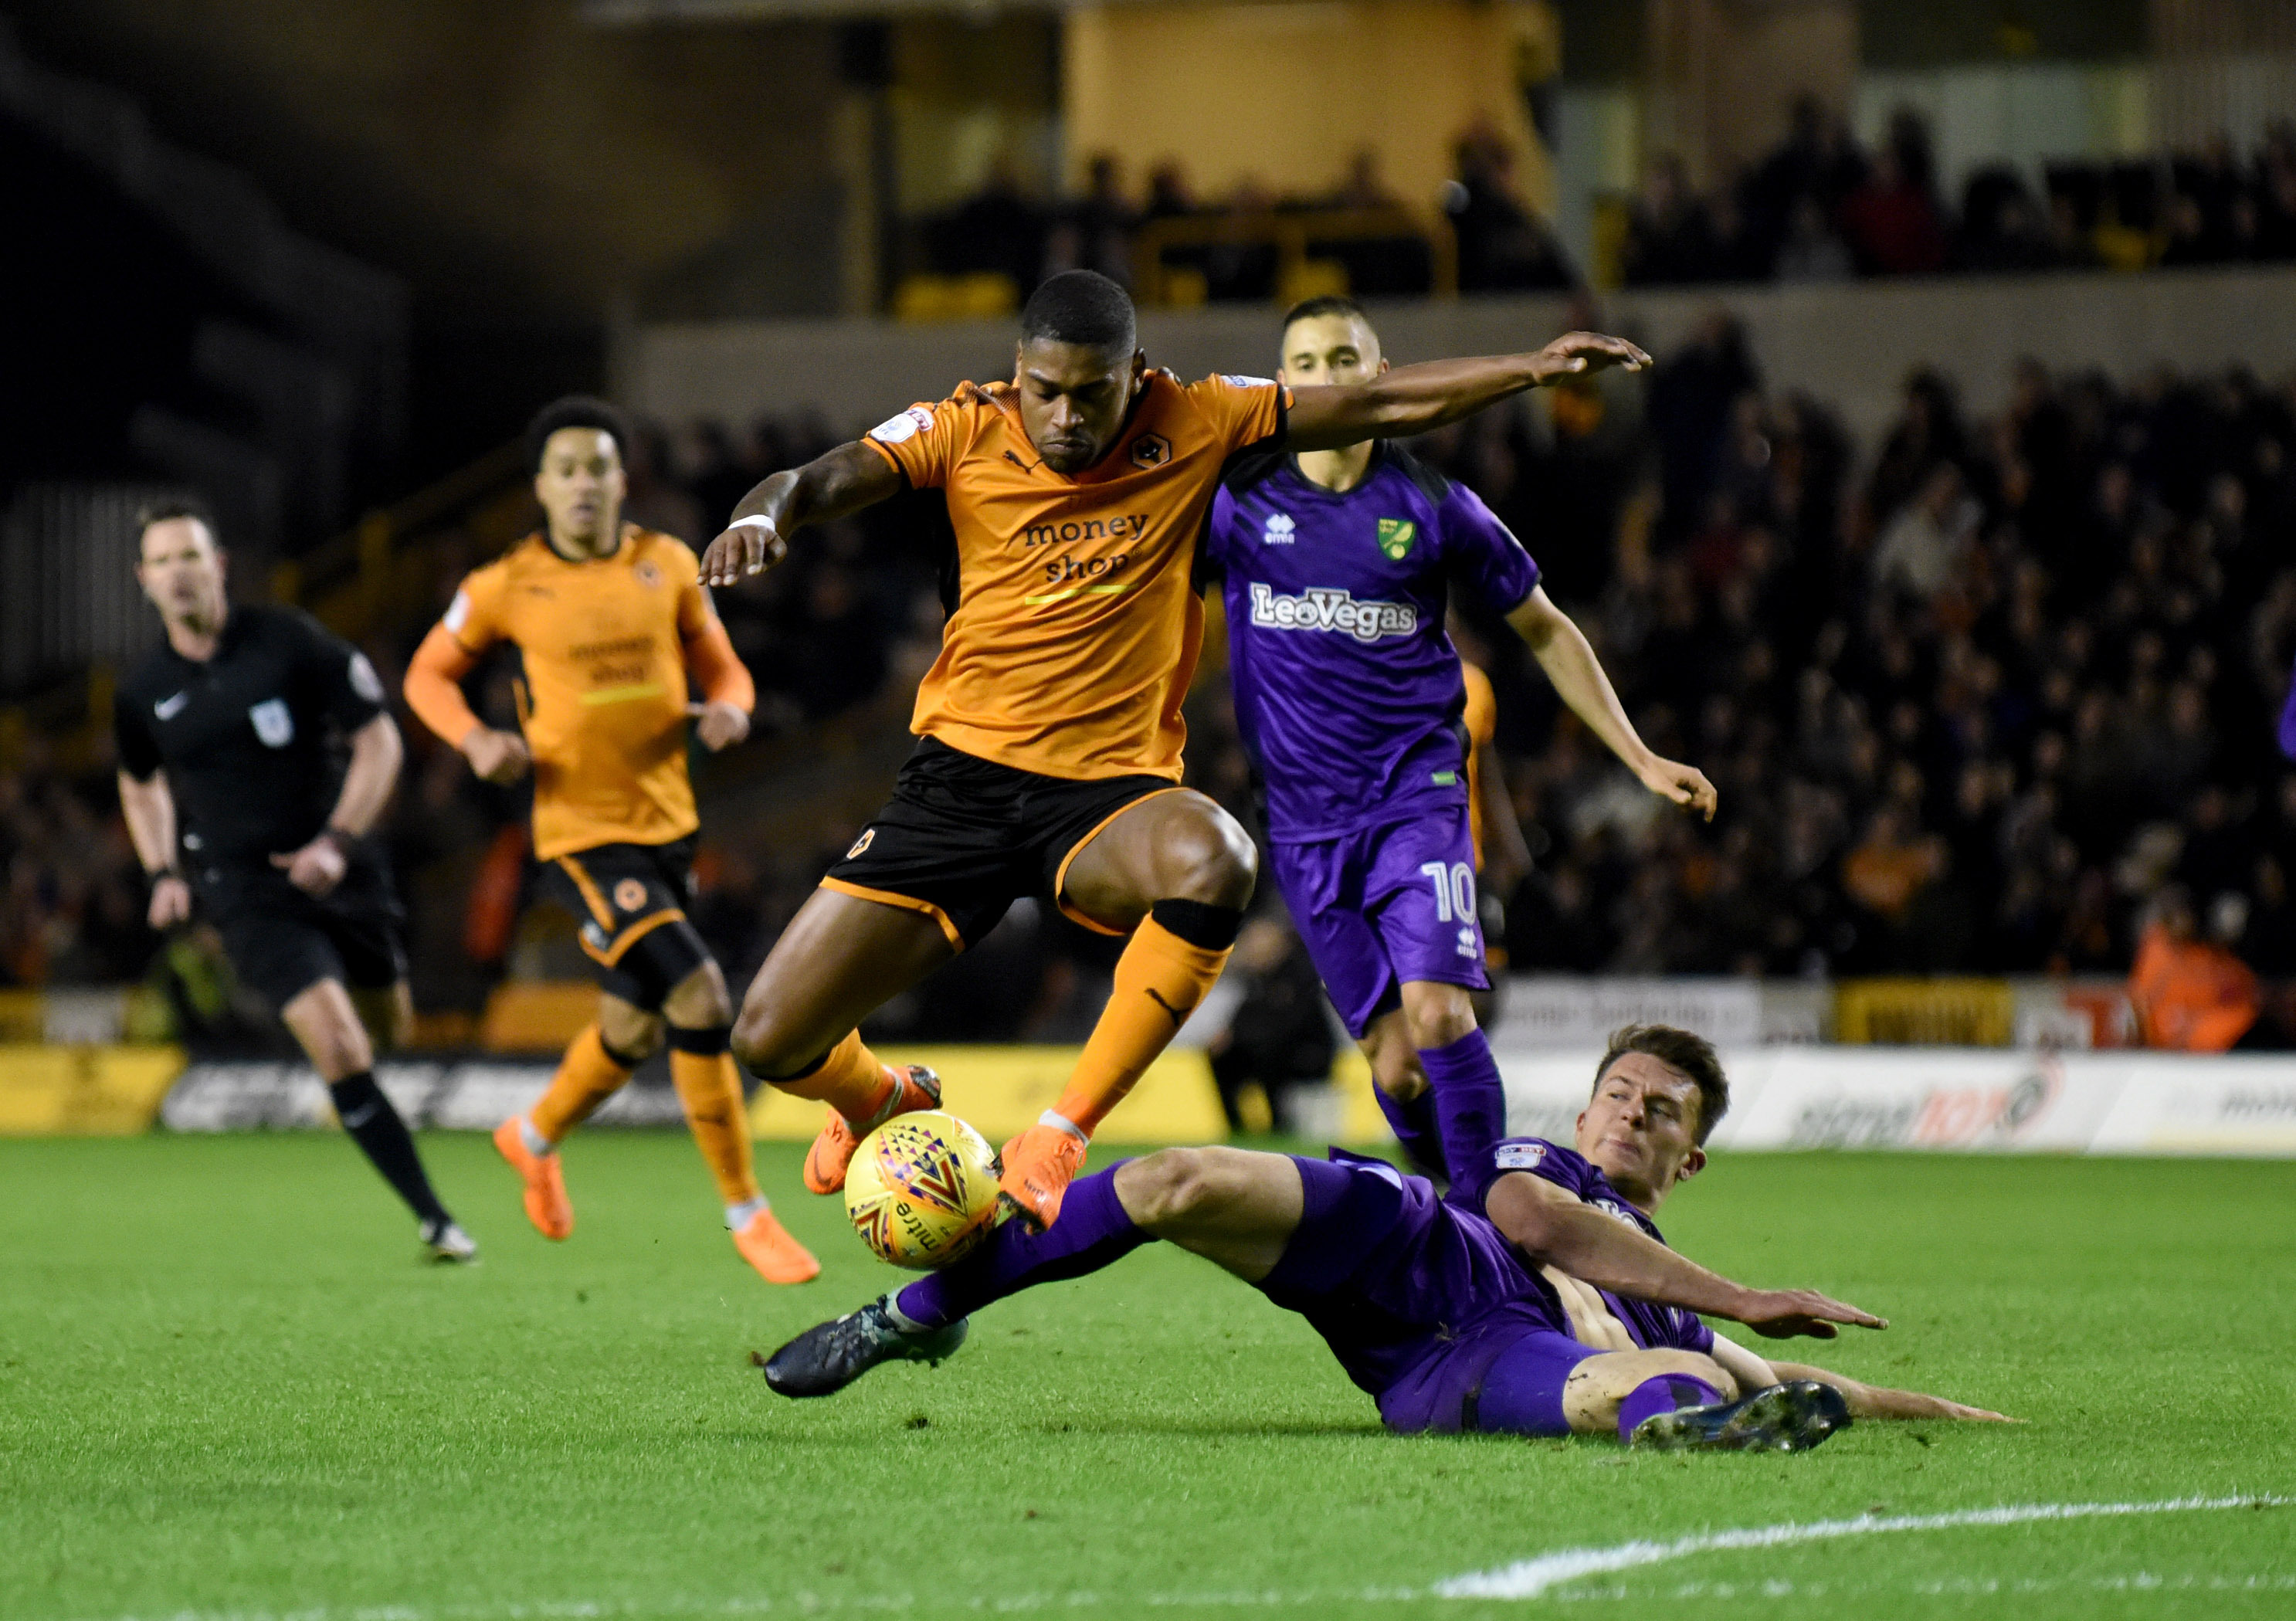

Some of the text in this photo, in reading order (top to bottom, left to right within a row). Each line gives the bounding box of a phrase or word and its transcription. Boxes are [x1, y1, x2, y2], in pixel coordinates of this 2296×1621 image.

[1024, 514, 1149, 546] money
[1046, 554, 1129, 582] shop
[1252, 584, 1416, 641] LeoVegas
[1421, 862, 1476, 925] 10
[896, 1202, 940, 1251] mitre
